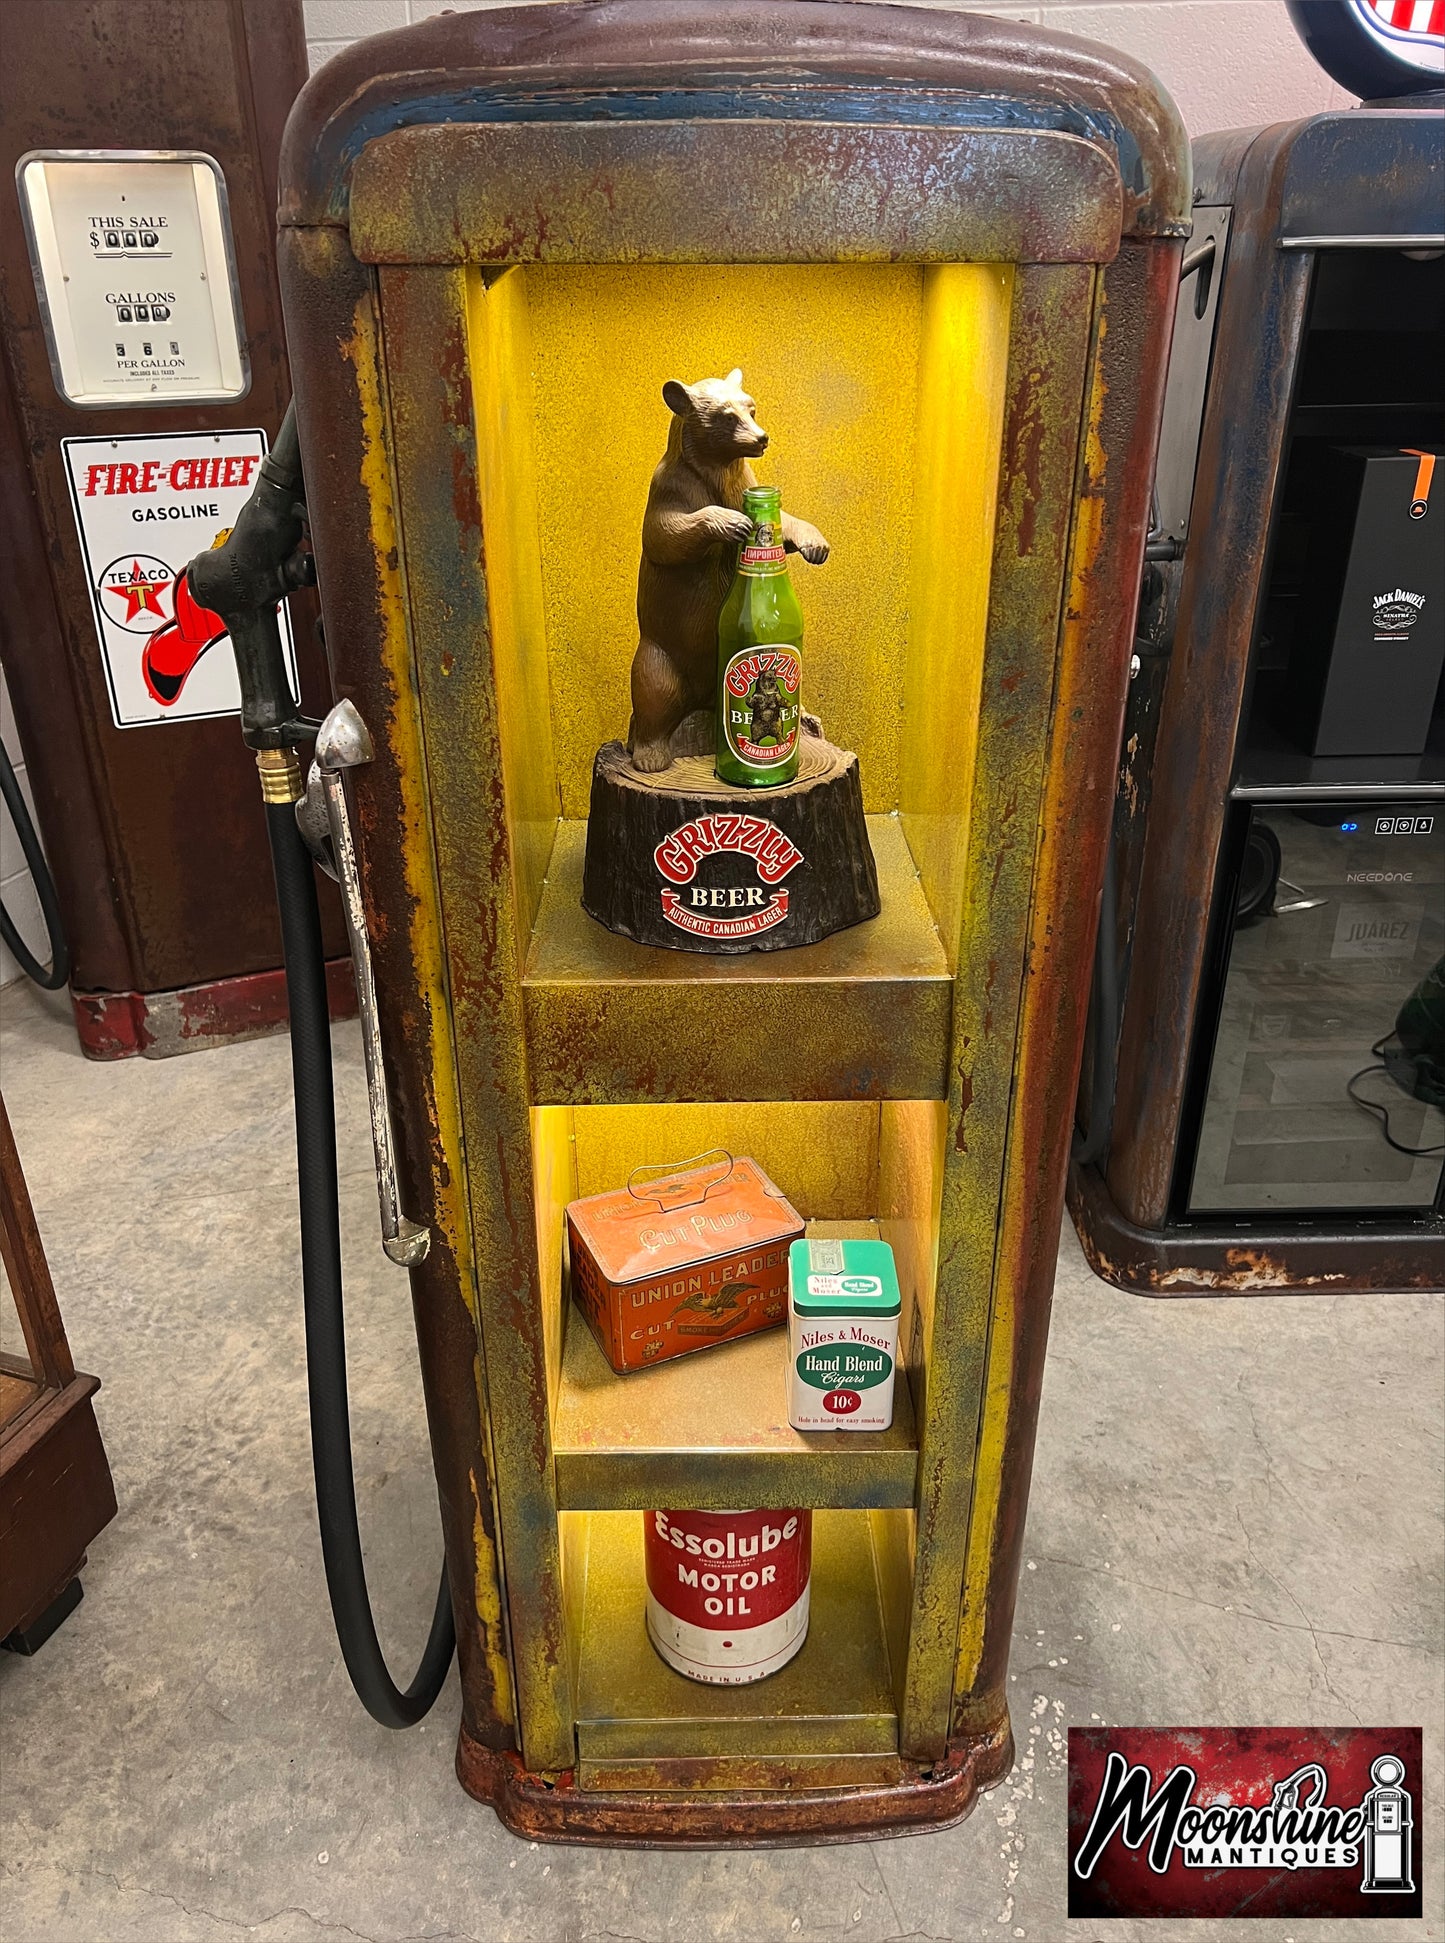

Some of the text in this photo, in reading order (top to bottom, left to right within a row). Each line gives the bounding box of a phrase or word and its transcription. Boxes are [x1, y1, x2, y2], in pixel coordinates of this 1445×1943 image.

[88, 216, 169, 228] THIS SALE
[105, 292, 177, 304] GALLONS
[117, 359, 186, 369] PER GALLON
[83, 455, 260, 497] FIRE-CHIEF
[132, 503, 220, 523] GASOLINE
[747, 547, 783, 560] IMPORTED
[108, 568, 169, 584] TEXACO
[126, 584, 155, 609] T
[1373, 592, 1394, 609] JACK
[725, 652, 801, 698] GRIZZLY
[743, 741, 791, 757] CANADIAN LAGER
[653, 813, 805, 885] GRIZZLY
[690, 886, 766, 908] BEER
[668, 906, 784, 935] AUTHENTIC CANADIAN LAGER
[638, 1208, 753, 1250] CUT PLUG
[631, 1275, 702, 1308] UNION
[630, 1319, 675, 1340] CUT
[801, 1326, 891, 1350] Niles & Moser
[805, 1355, 883, 1372] Hand Blend
[821, 1371, 865, 1389] Cigars
[832, 1395, 853, 1410] 10¢
[655, 1510, 798, 1560] Essolube
[678, 1563, 777, 1593] MOTOR
[704, 1596, 751, 1616] OIL
[687, 1669, 713, 1682] MADE
